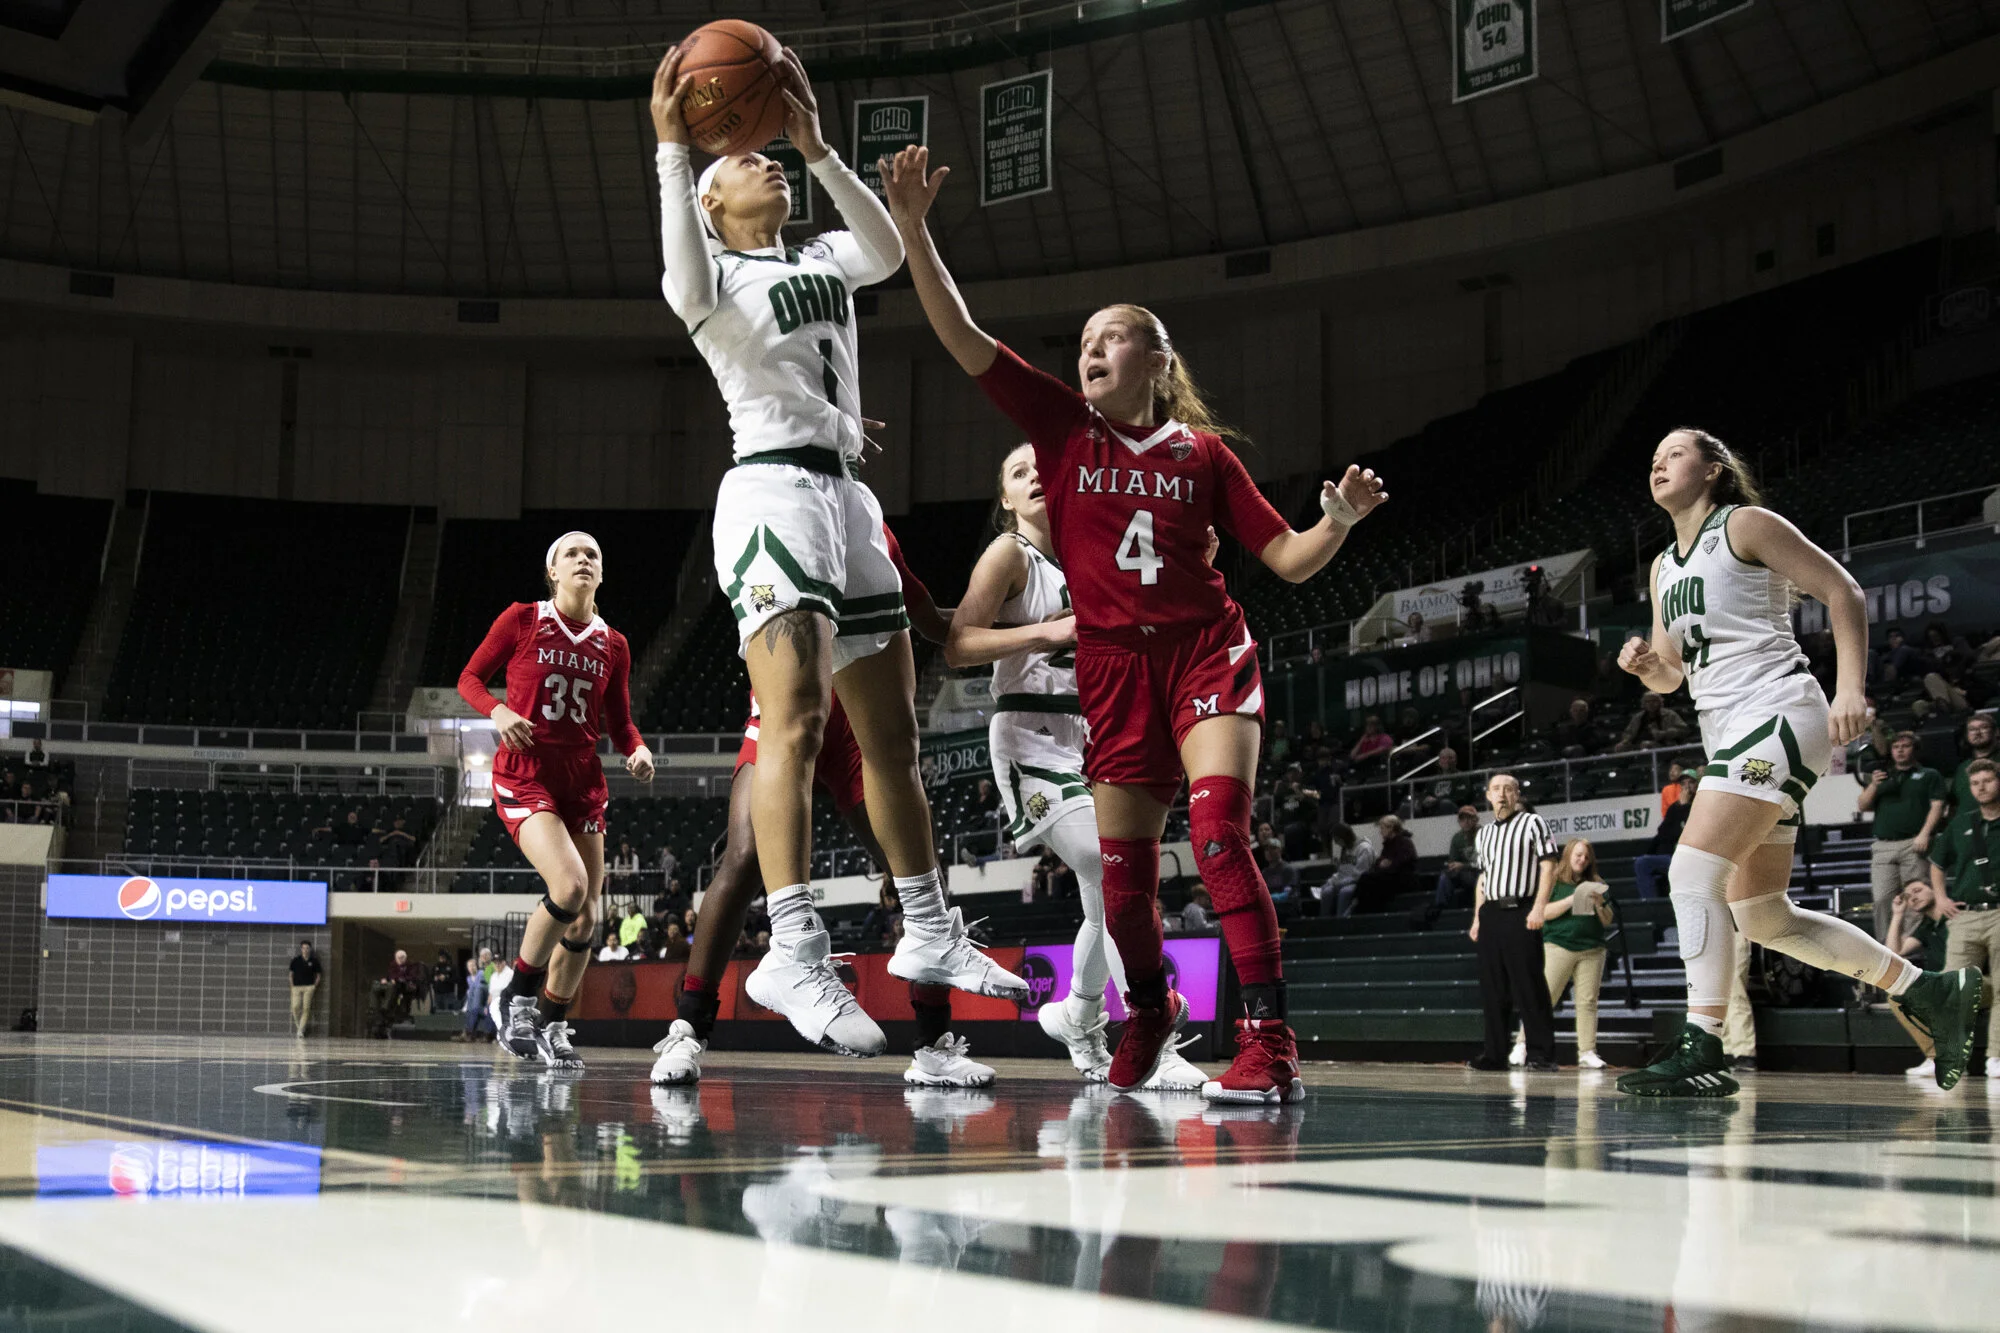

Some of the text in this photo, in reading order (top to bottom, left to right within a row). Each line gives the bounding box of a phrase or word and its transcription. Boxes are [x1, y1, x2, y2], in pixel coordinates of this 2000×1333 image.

[1476, 3, 1511, 31] OHIO
[1482, 26, 1507, 51] 54
[997, 85, 1035, 116] OHIO
[871, 106, 911, 133] OHIO
[1005, 123, 1025, 136] MAC
[862, 132, 919, 142] MEN'S BASKETBALL
[987, 128, 1043, 150] TOURNAMENT
[990, 139, 1040, 160] CHAMPIONS
[991, 163, 1040, 183] 1994 2005
[1018, 175, 1040, 188] 2012
[768, 274, 849, 335] OHIO
[818, 338, 838, 408] 1
[1077, 465, 1195, 504] MIAMI
[1115, 509, 1164, 585] 4
[1661, 576, 1706, 633] OHIO
[537, 648, 605, 678] MIAMI
[1345, 651, 1521, 710] HOME OF OHIO
[541, 673, 594, 724] 35
[1192, 694, 1219, 716] M
[583, 820, 600, 834] M
[1574, 813, 1617, 832] SECTION
[1624, 808, 1650, 829] CS7
[166, 885, 254, 917] pepsi
